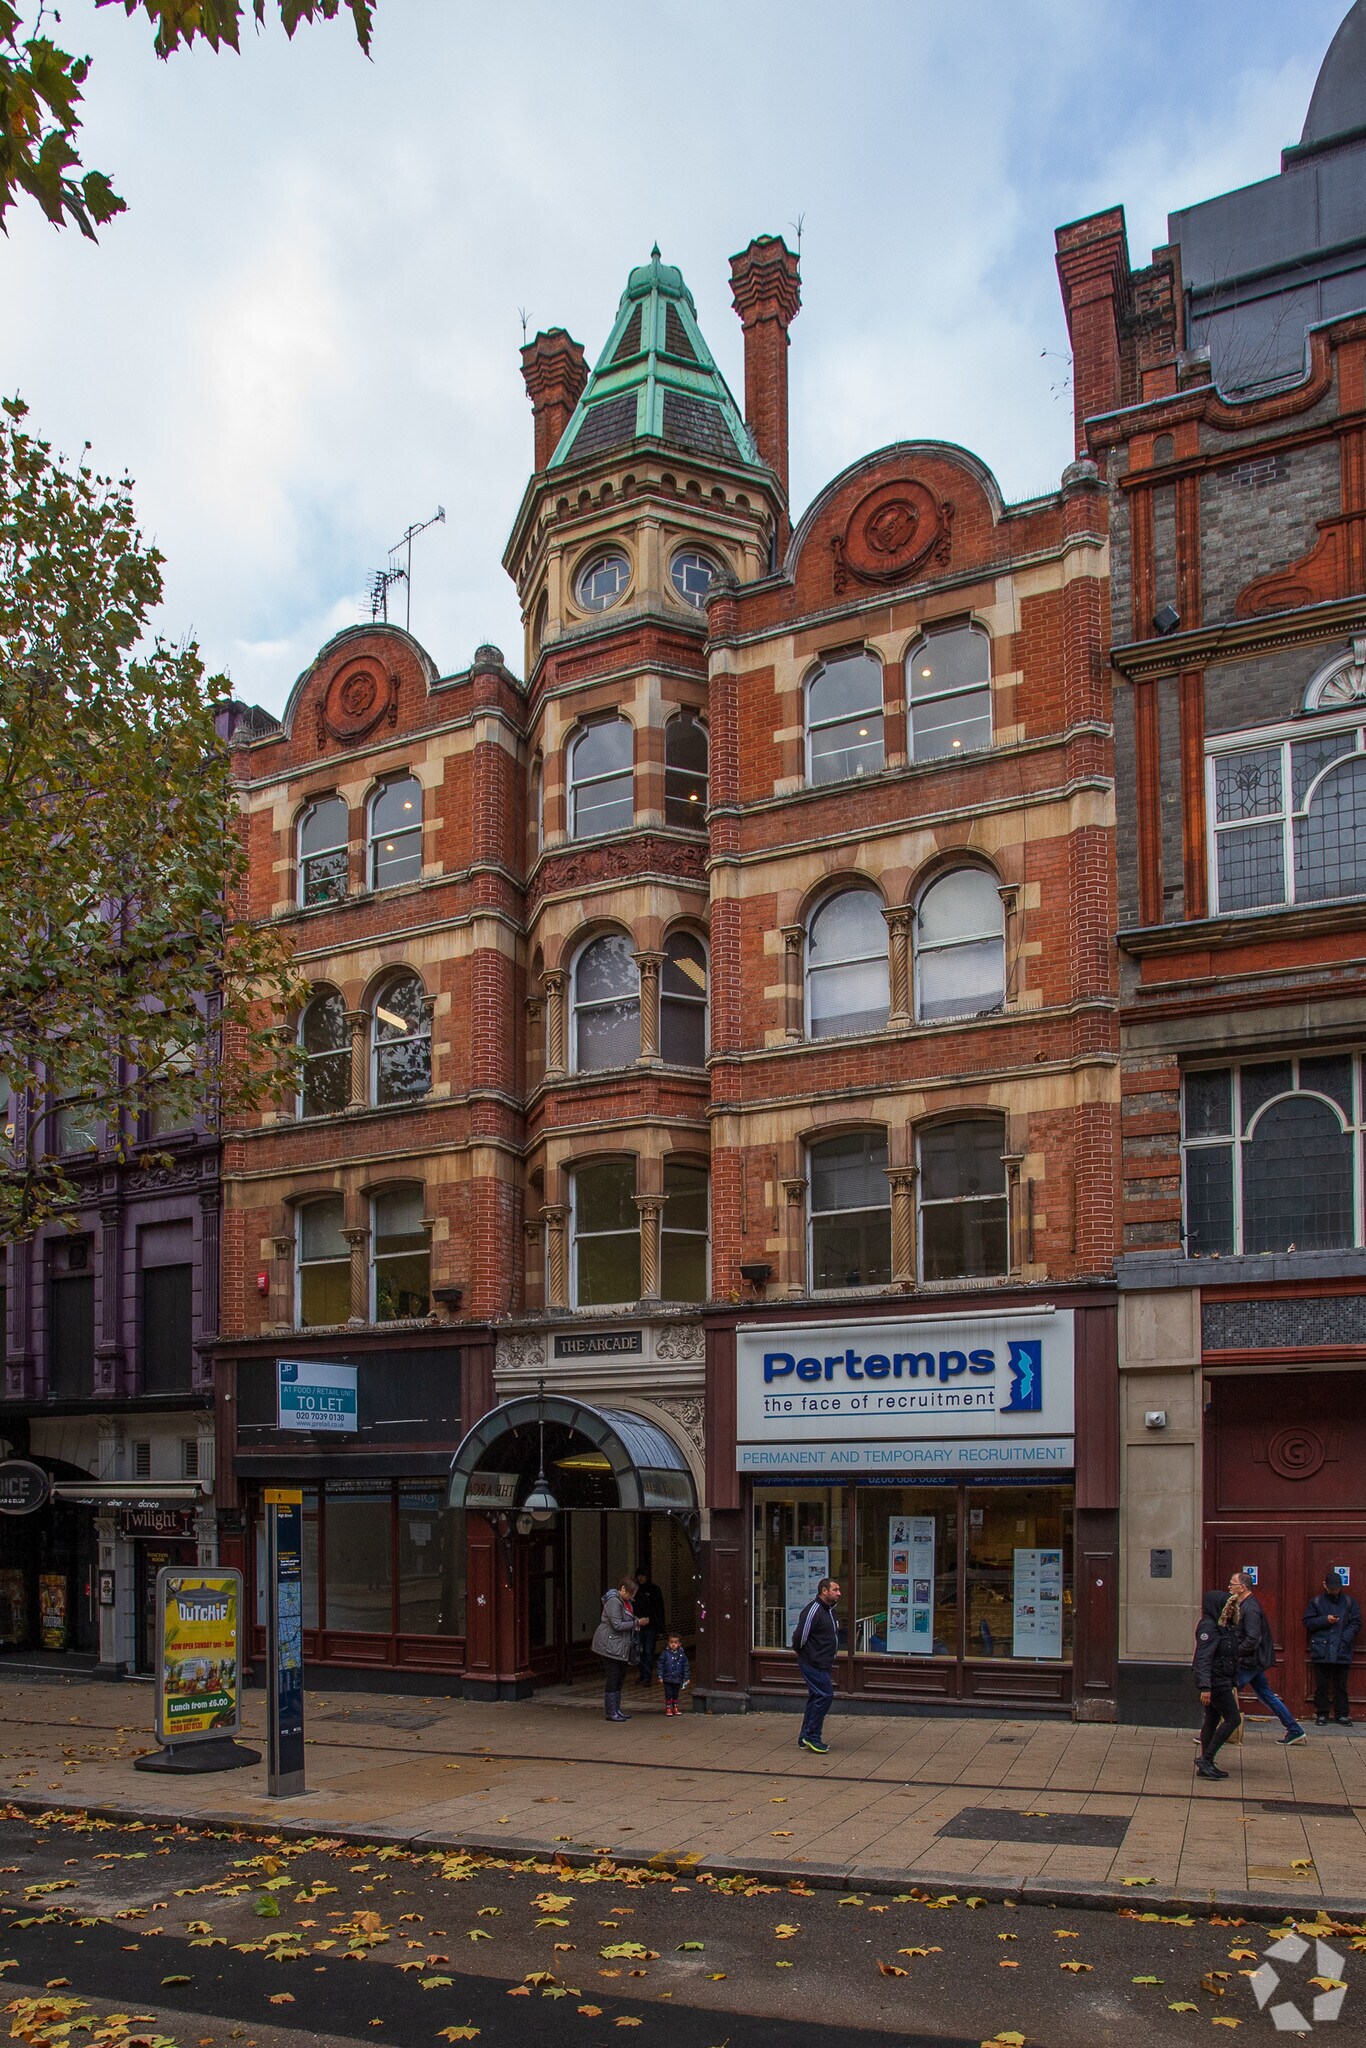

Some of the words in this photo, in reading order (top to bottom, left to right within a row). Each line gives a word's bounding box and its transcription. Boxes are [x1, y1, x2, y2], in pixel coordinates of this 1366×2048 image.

[560, 1339, 585, 1353] THE
[588, 1337, 638, 1352] ARCADE
[764, 1349, 995, 1383] Pertemps
[297, 1396, 315, 1410] TO
[320, 1397, 343, 1411] LET
[764, 1398, 792, 1411] the
[802, 1397, 841, 1410] face
[851, 1395, 868, 1409] of
[878, 1391, 994, 1408] recruitment
[296, 1411, 309, 1420] 020
[311, 1412, 327, 1421] 7039
[328, 1413, 344, 1421] 0130
[743, 1451, 826, 1464] PERMANENT
[830, 1451, 859, 1463] AND
[864, 1449, 953, 1462] TEMPORARY
[959, 1447, 1066, 1461] RECRUITMENT
[122, 1509, 177, 1531] Twilight
[171, 1642, 182, 1650] NOW
[183, 1642, 194, 1650] OPEN
[194, 1641, 212, 1649] SUNDAY
[171, 1702, 190, 1712] Lunch
[191, 1701, 208, 1709] from
[208, 1698, 228, 1707] £6.00
